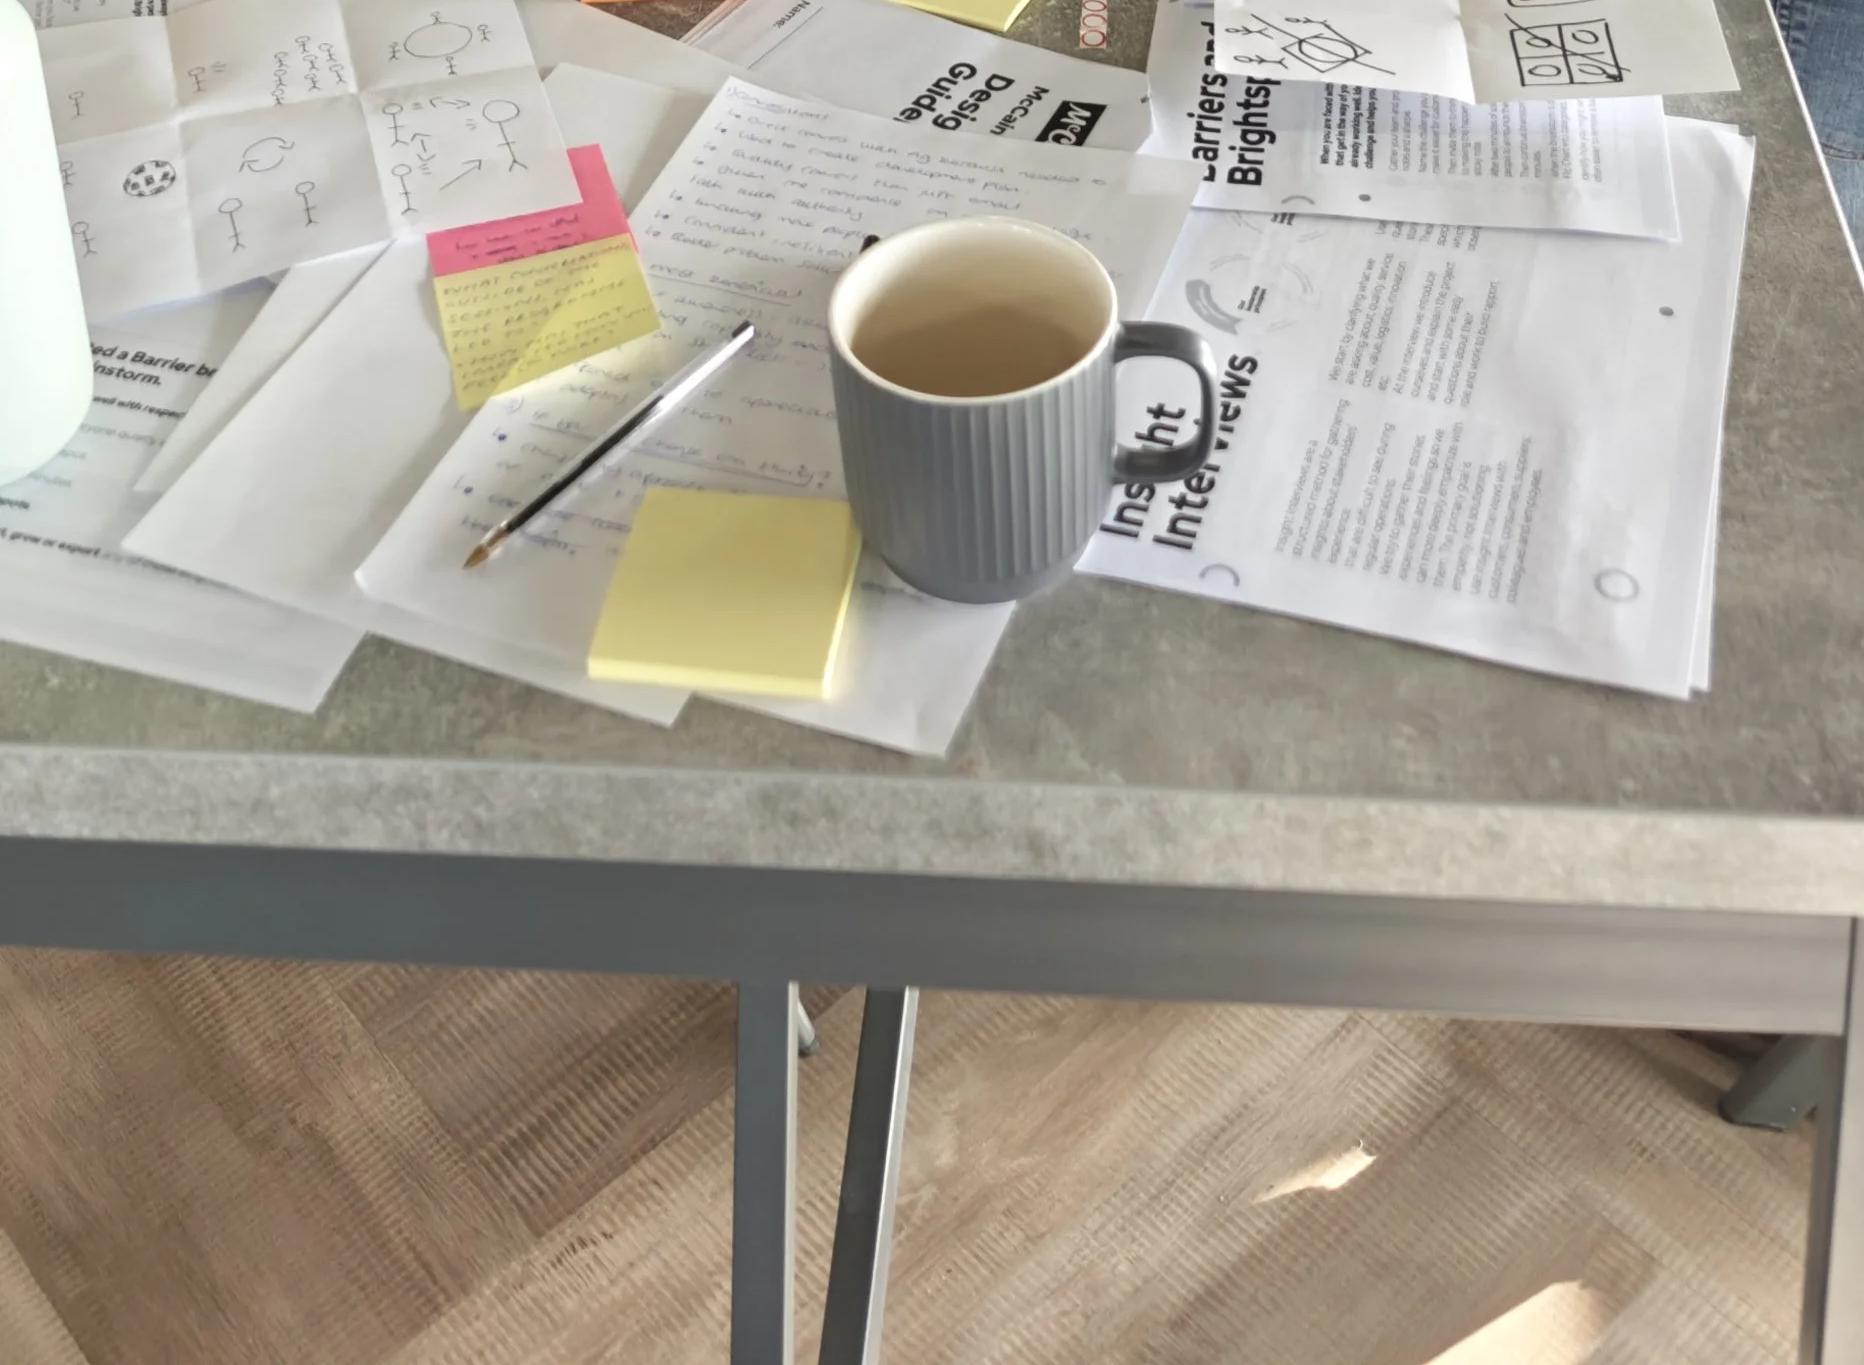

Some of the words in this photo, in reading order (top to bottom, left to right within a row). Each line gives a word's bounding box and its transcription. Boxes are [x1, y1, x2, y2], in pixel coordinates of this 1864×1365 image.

[773, 0, 810, 29] Name:
[893, 61, 978, 122] Guide
[931, 73, 1015, 130] Desig
[990, 85, 1049, 135] McCain
[1340, 84, 1350, 93] yo
[1048, 101, 1091, 147] McC
[1227, 76, 1282, 186] Brightsp
[94, 362, 161, 386] instorm.
[117, 350, 128, 360] a
[131, 351, 195, 373] Barrier
[117, 400, 141, 410] with
[1099, 403, 1186, 538] Insht
[1152, 353, 1258, 550] Inteiews
[42, 537, 57, 547] or
